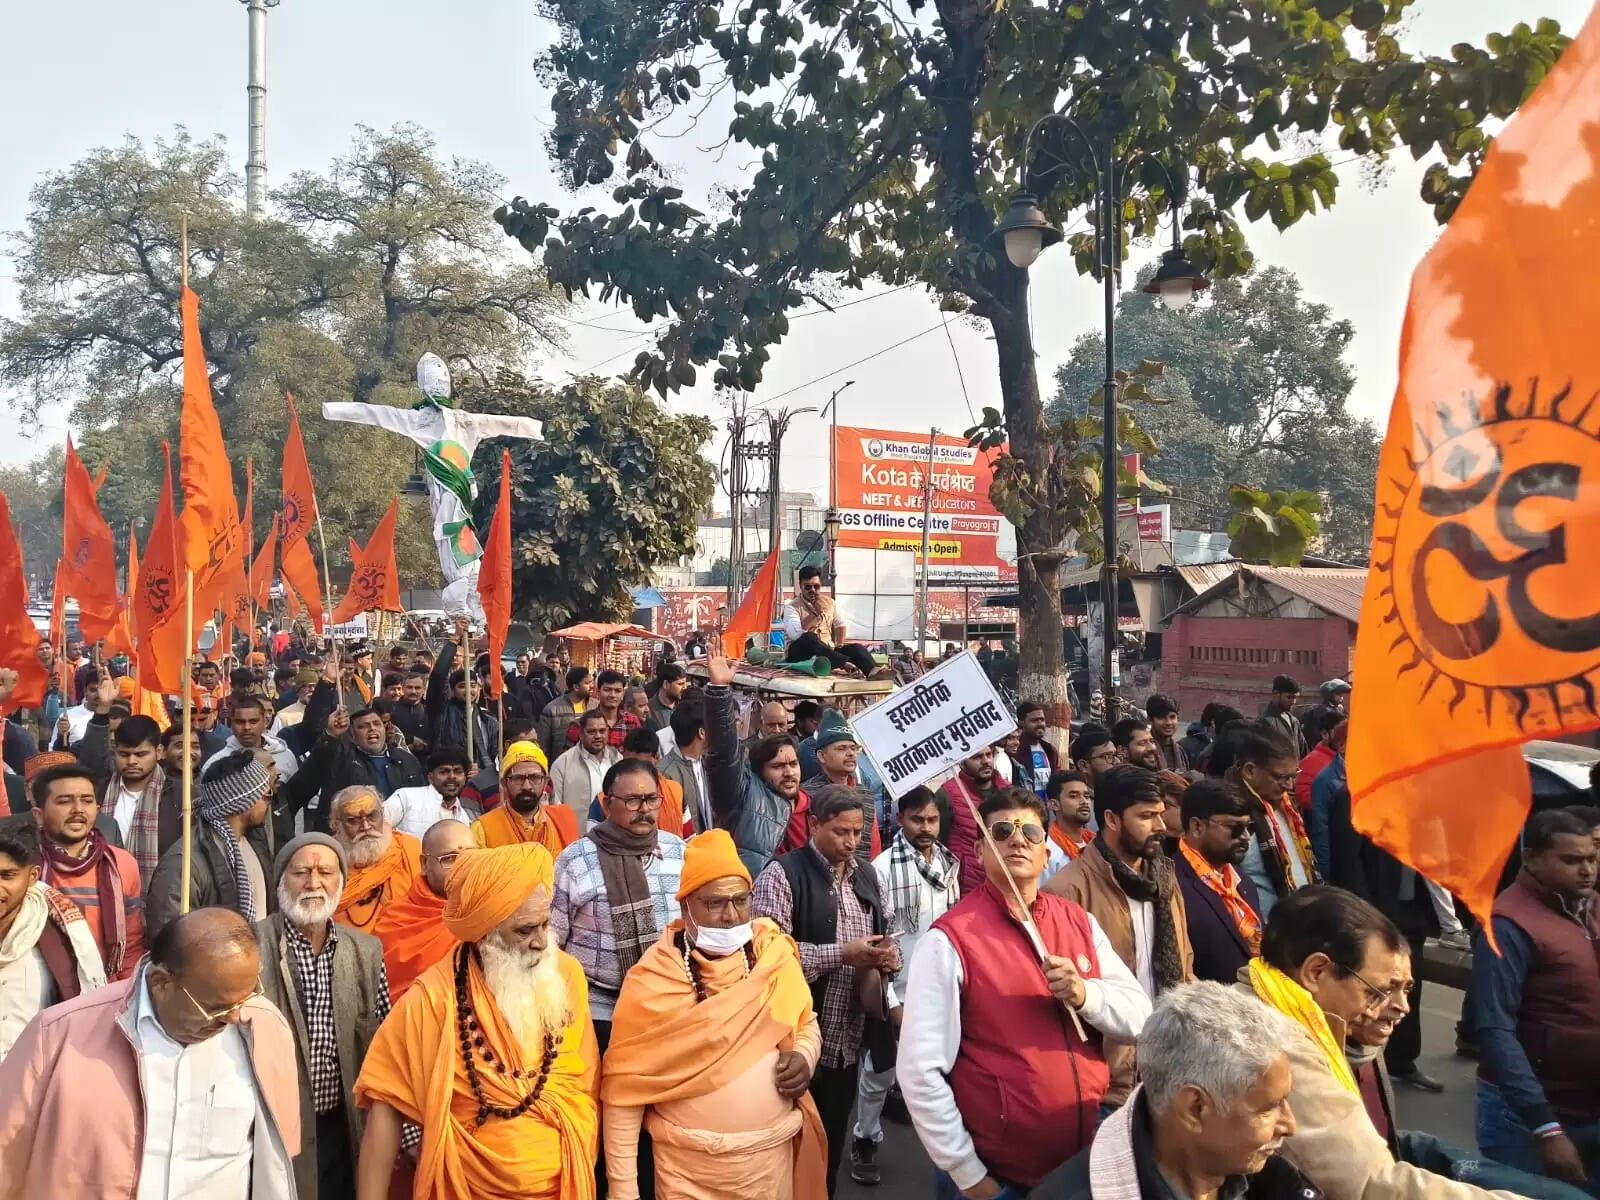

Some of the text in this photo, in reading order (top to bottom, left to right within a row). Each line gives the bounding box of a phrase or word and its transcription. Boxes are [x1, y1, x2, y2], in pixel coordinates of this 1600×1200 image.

[886, 443, 909, 454] Khan
[940, 447, 972, 458] Studies
[861, 463, 907, 487] Kota
[862, 492, 976, 511] NEET & JEE ducators
[863, 513, 905, 528] Offline
[953, 519, 991, 531] Prayagraj
[933, 544, 958, 554] Open
[886, 679, 952, 733] इस्लामिक
[883, 700, 1003, 782] आतंकवाद मुर्दाबाद
